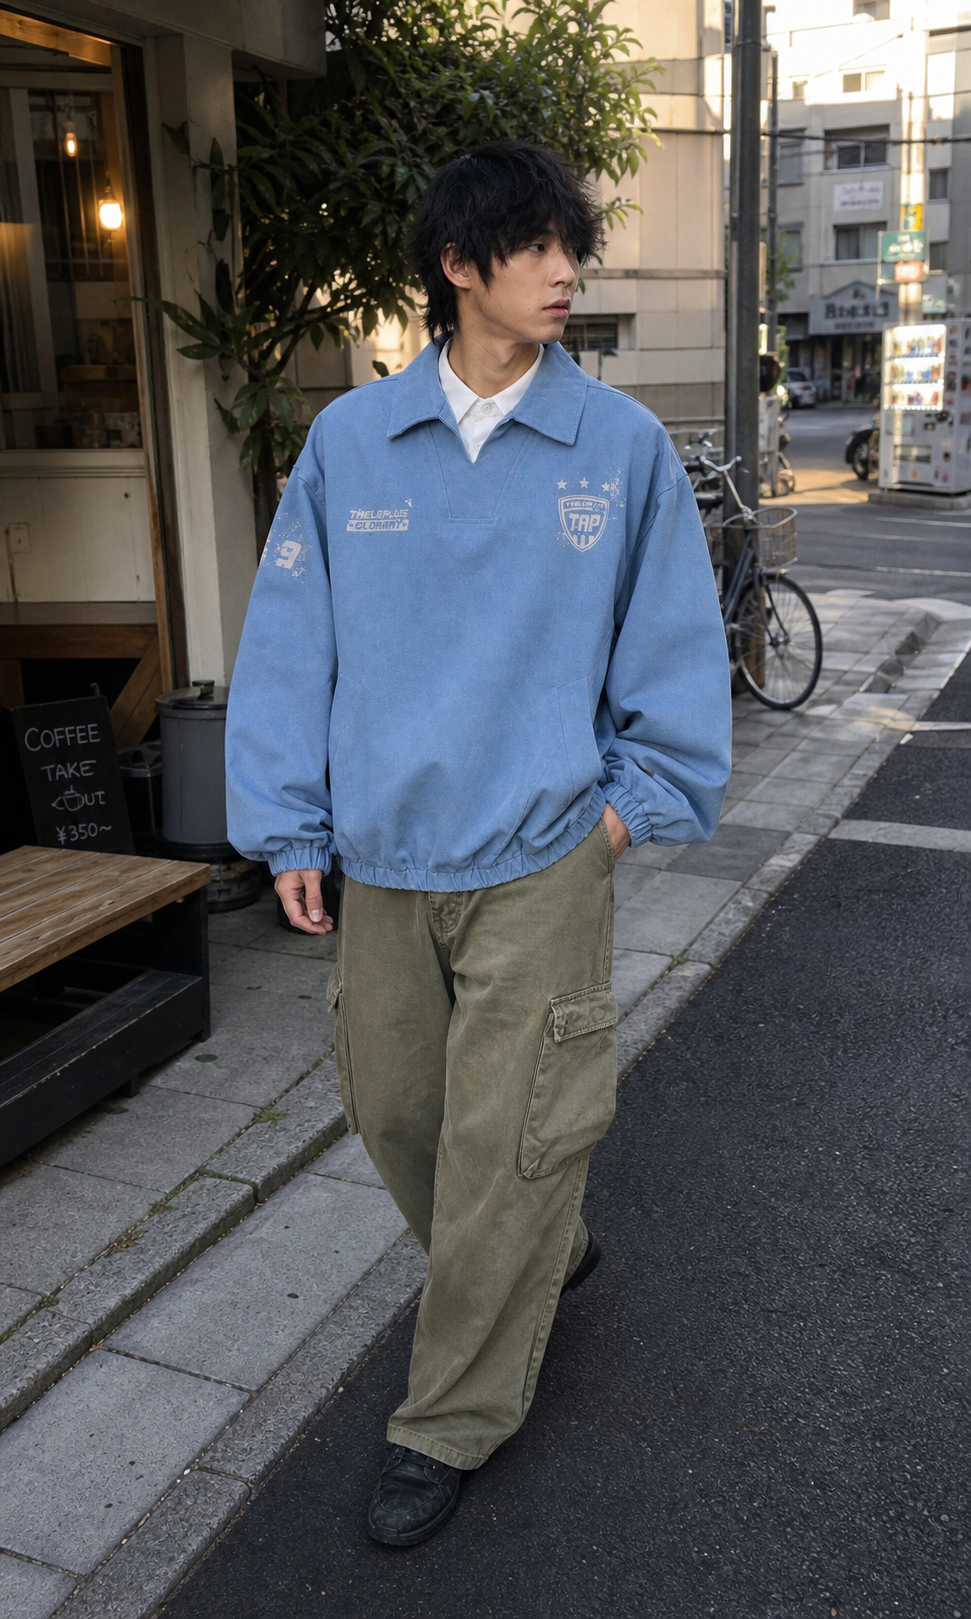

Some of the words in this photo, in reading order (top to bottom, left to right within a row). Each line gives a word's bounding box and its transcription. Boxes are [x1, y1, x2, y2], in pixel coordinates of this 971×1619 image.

[568, 513, 601, 533] TAP
[24, 723, 101, 752] COFFEE
[40, 760, 97, 782] TAKE
